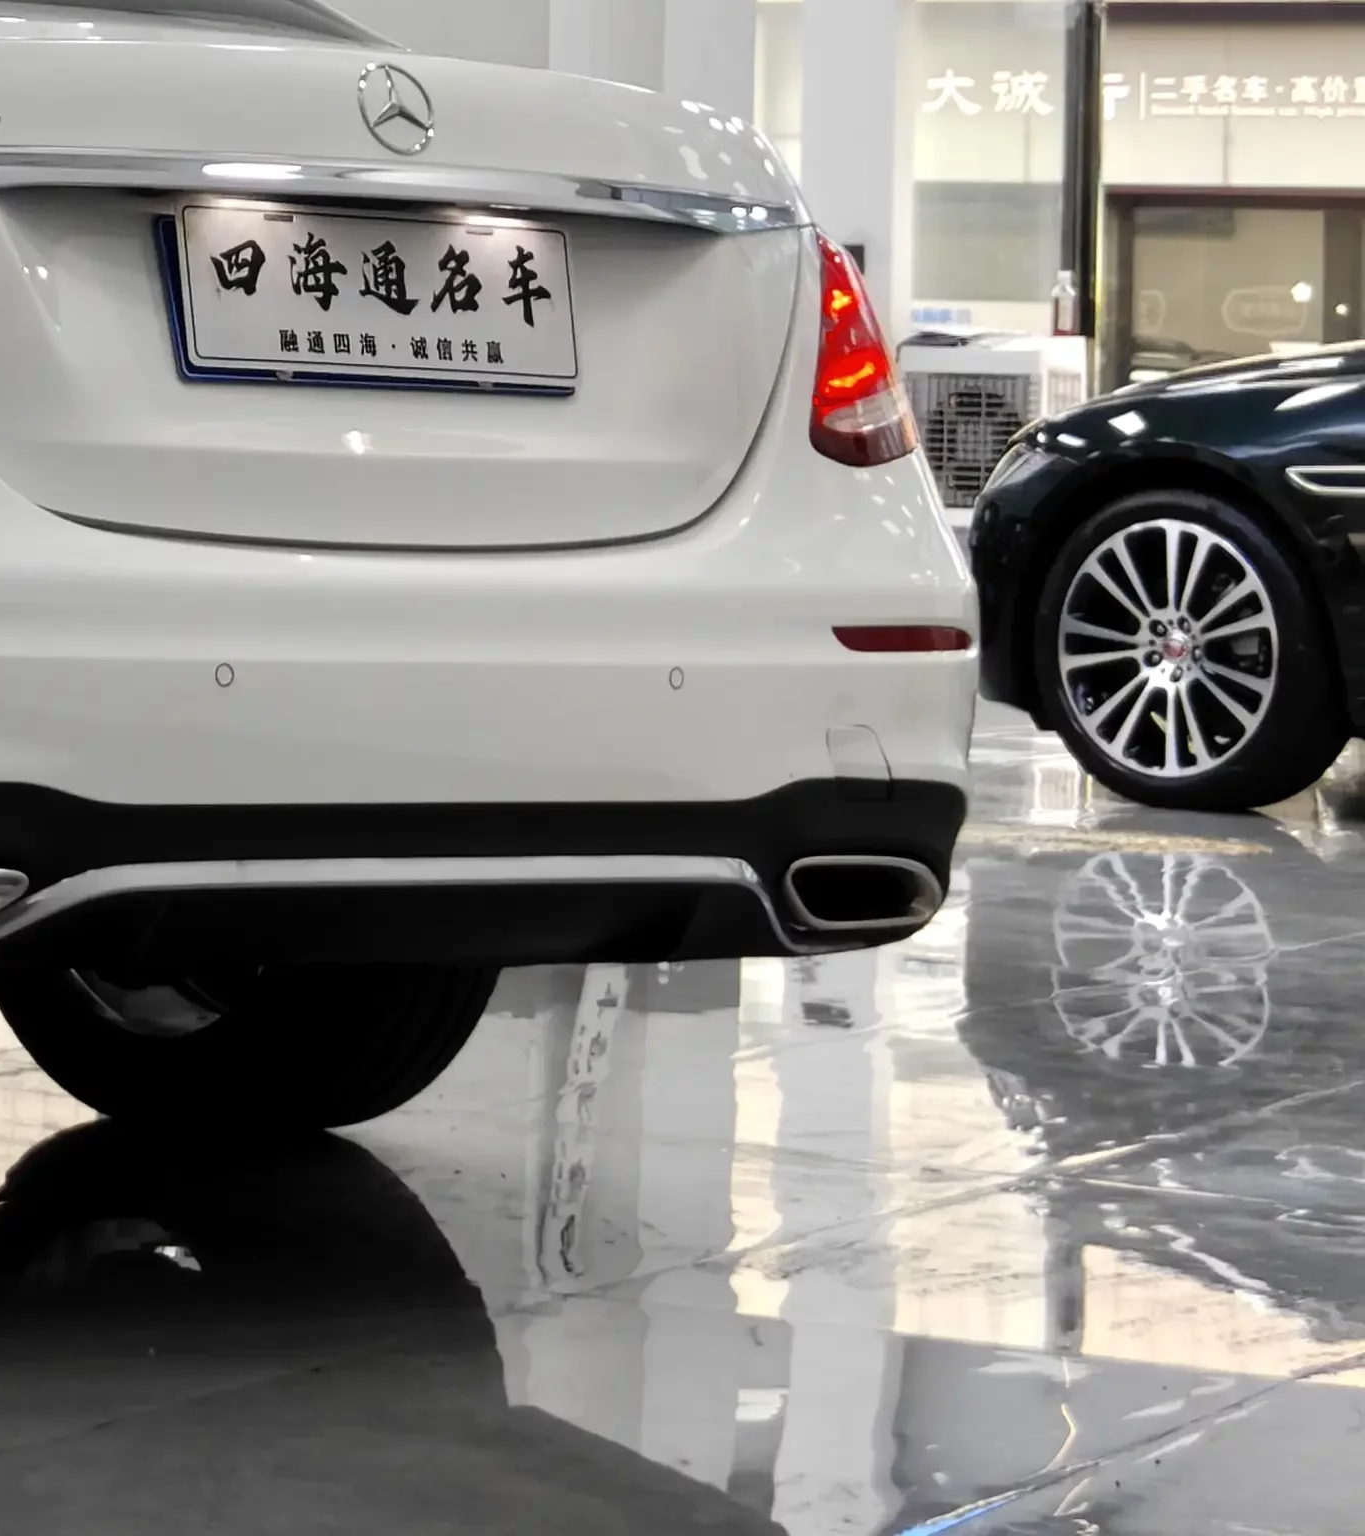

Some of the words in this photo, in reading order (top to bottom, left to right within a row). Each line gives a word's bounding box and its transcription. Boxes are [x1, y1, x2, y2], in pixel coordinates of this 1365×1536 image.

[1150, 74, 1365, 104] 二手名车·高价
[210, 232, 552, 327] 四海通名车
[278, 329, 505, 364] 融通四海·诚信共赢
